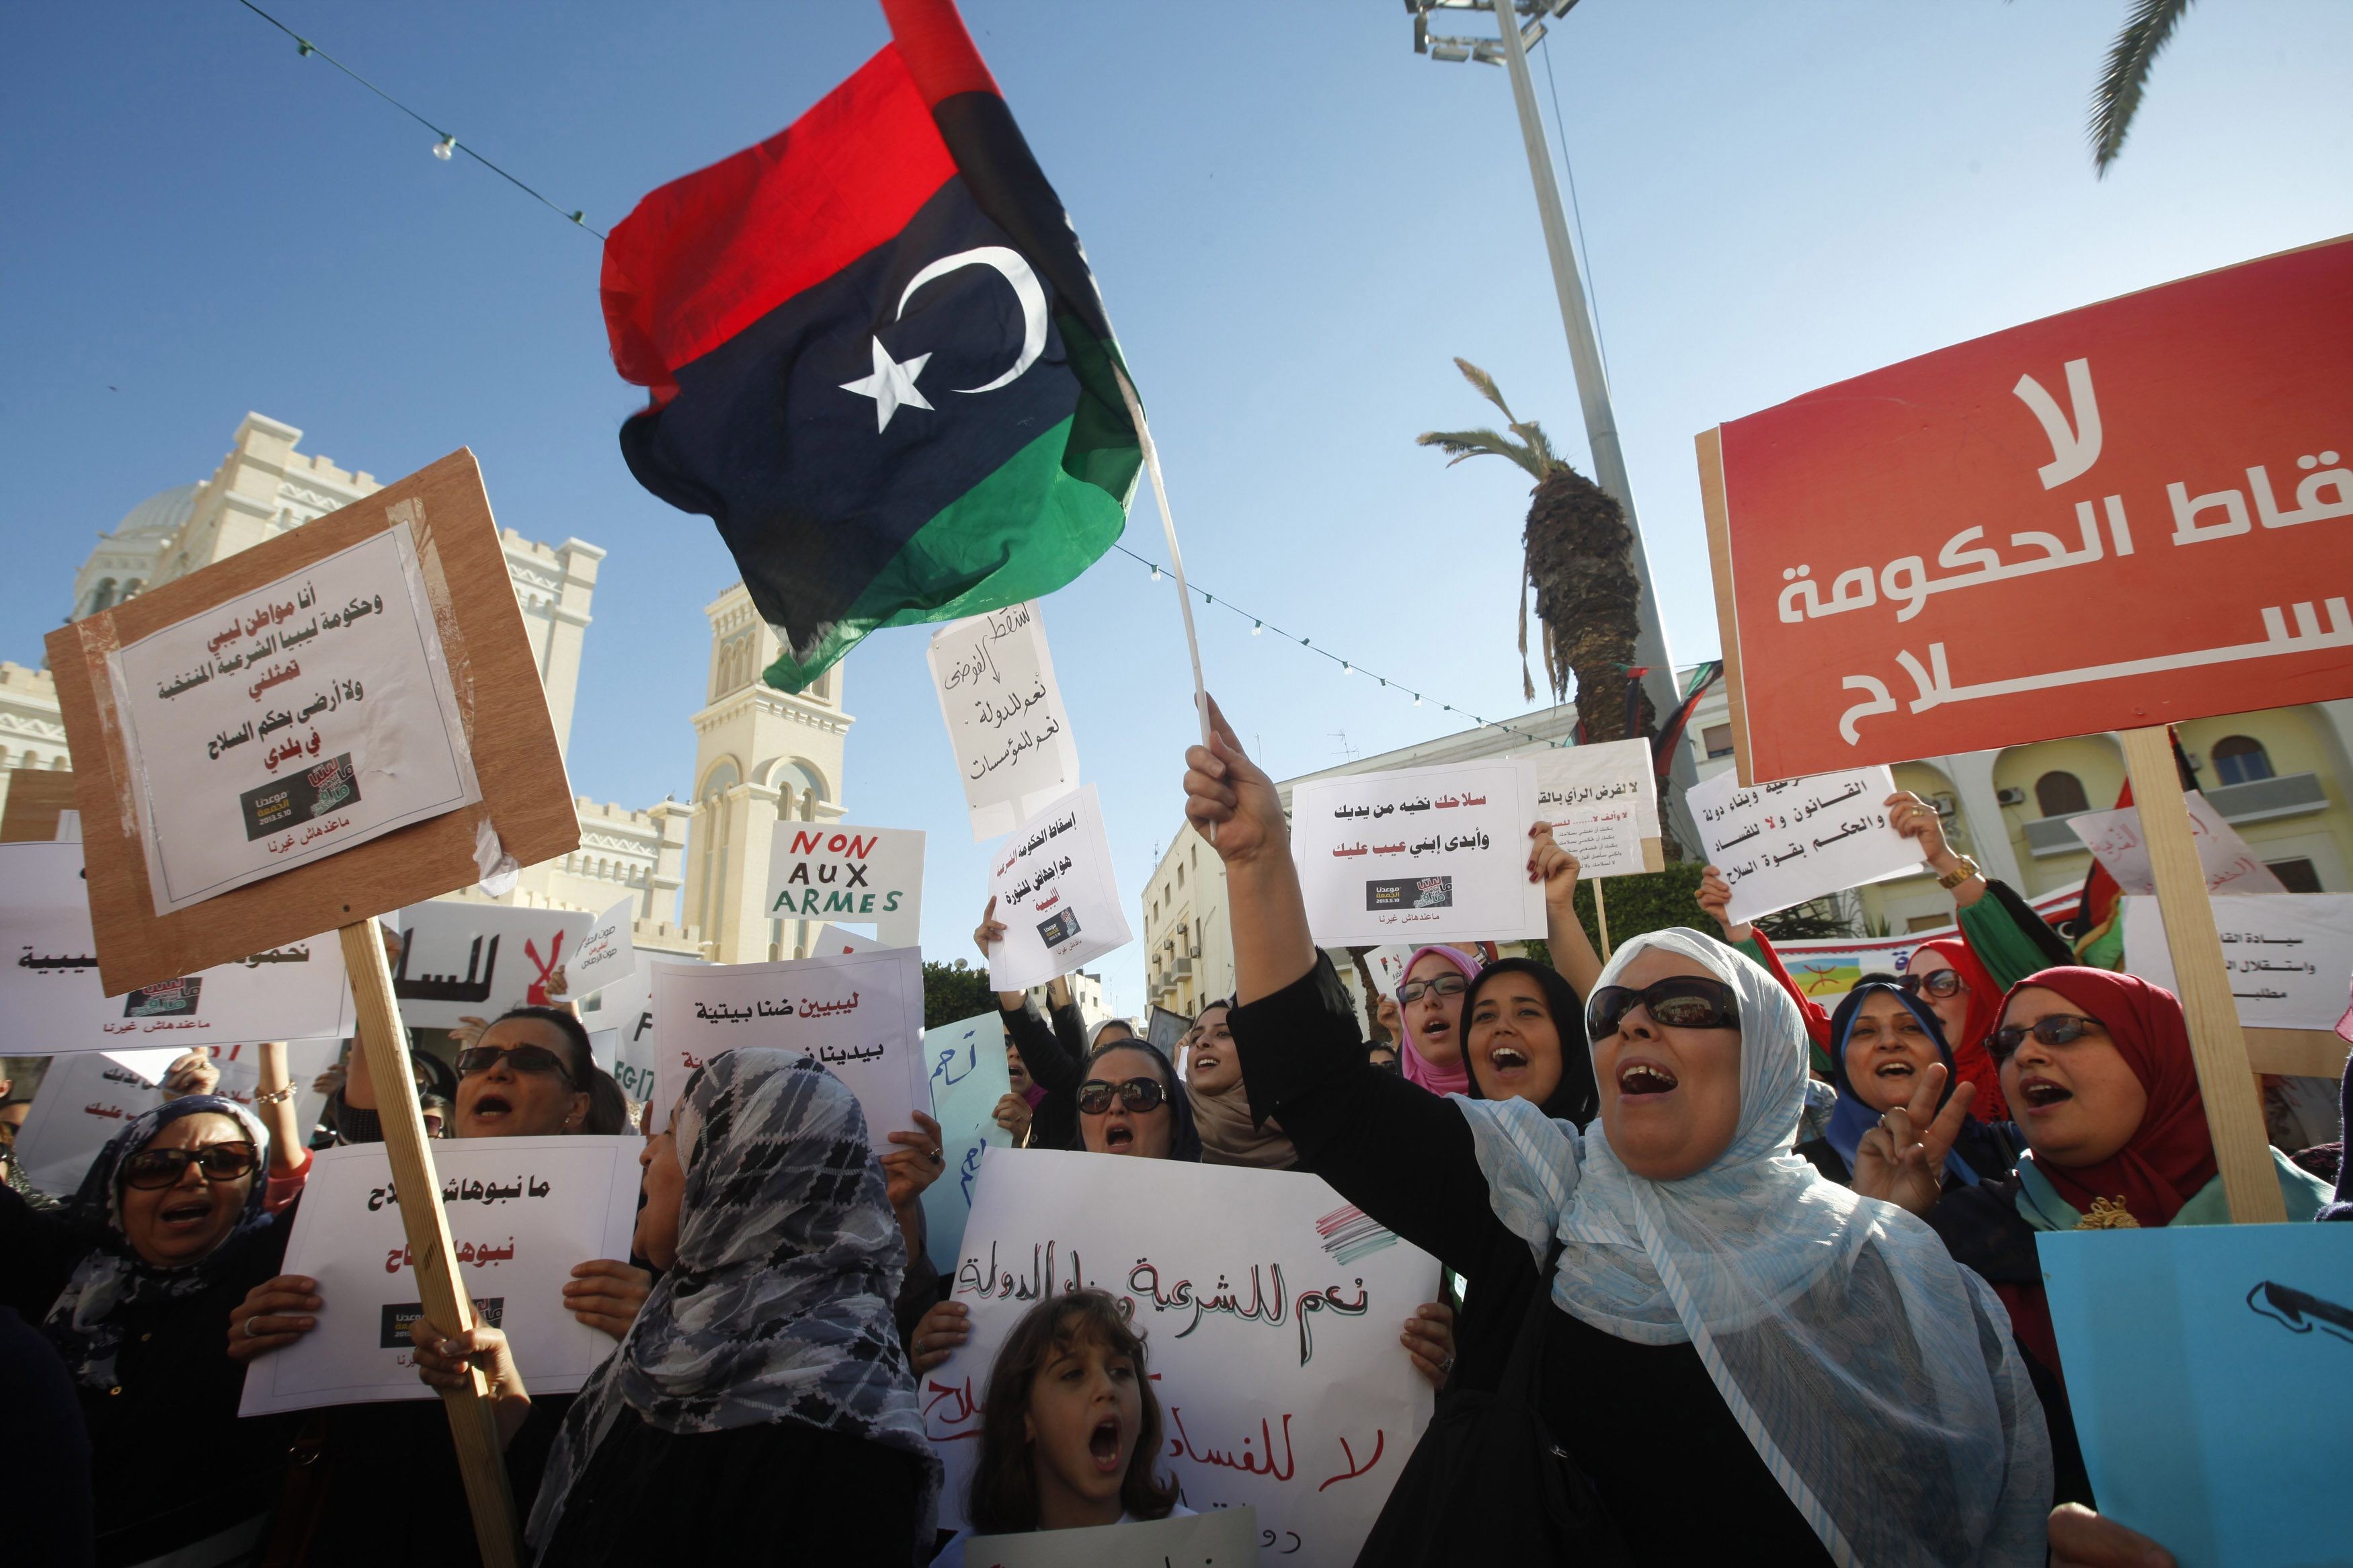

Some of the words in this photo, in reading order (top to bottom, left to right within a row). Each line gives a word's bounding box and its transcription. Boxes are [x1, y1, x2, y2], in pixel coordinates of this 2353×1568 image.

[2012, 356, 2104, 491] لا
[2166, 450, 2353, 546] قاط
[1777, 493, 2135, 624] الحكومة
[297, 580, 316, 609] أنا
[245, 601, 294, 637] مواطن
[321, 594, 383, 630] وحكومة
[207, 618, 242, 656] ليبي
[278, 617, 319, 651] ليبيا
[216, 634, 278, 676] الشرعية
[157, 661, 214, 701] المنتخبة
[249, 659, 301, 702] تمثلني
[1838, 595, 2353, 746] سلاح
[297, 679, 342, 724] أرضى
[342, 679, 364, 701] ولا
[1023, 681, 1047, 718] نعم
[975, 692, 1022, 729] للدولة
[207, 720, 254, 760] السلاح
[258, 710, 294, 742] بحكم
[1036, 716, 1060, 752] نعم
[264, 737, 302, 774] بلدي
[306, 726, 321, 757] في
[970, 730, 1033, 780] للمؤسسات
[255, 791, 288, 808] موعدنا
[1434, 792, 1486, 809] سلاحك
[1538, 791, 1562, 806] بالق
[1565, 787, 1593, 805] الرأي
[1629, 782, 1638, 793] لا
[259, 809, 292, 825] 2013.5.10
[1049, 811, 1077, 839] إسقاط
[1334, 804, 1370, 821] يديك
[1373, 803, 1394, 819] من
[1702, 806, 1724, 822] دولة
[268, 834, 294, 854] غيرنا
[789, 830, 878, 860] NON
[1018, 828, 1047, 858] الحكومة
[1332, 841, 1368, 860] عليك
[1372, 841, 1406, 857] عيب
[1409, 834, 1441, 859] إبني
[1444, 827, 1490, 852] وأبدى
[1058, 855, 1072, 876] هو
[1761, 843, 1807, 868] بقوة
[788, 862, 868, 888] AUX
[1033, 860, 1060, 891] إجهاض
[1726, 860, 1759, 884] السلاح
[772, 889, 904, 915] ARMES
[1004, 879, 1032, 905] للثورة
[1379, 914, 1398, 924] غيرنا
[524, 929, 565, 1006] لا
[757, 998, 794, 1018] ضنا
[103, 1020, 138, 1035] غيرنا
[820, 1043, 884, 1066] بيدينا
[528, 1174, 551, 1199] ما
[957, 1239, 1056, 1302] الدولة
[1126, 1256, 1289, 1339] للشرعية
[1296, 1277, 1369, 1367] نعم
[1168, 1407, 1295, 1481] للفساد
[1318, 1429, 1384, 1493] لا
